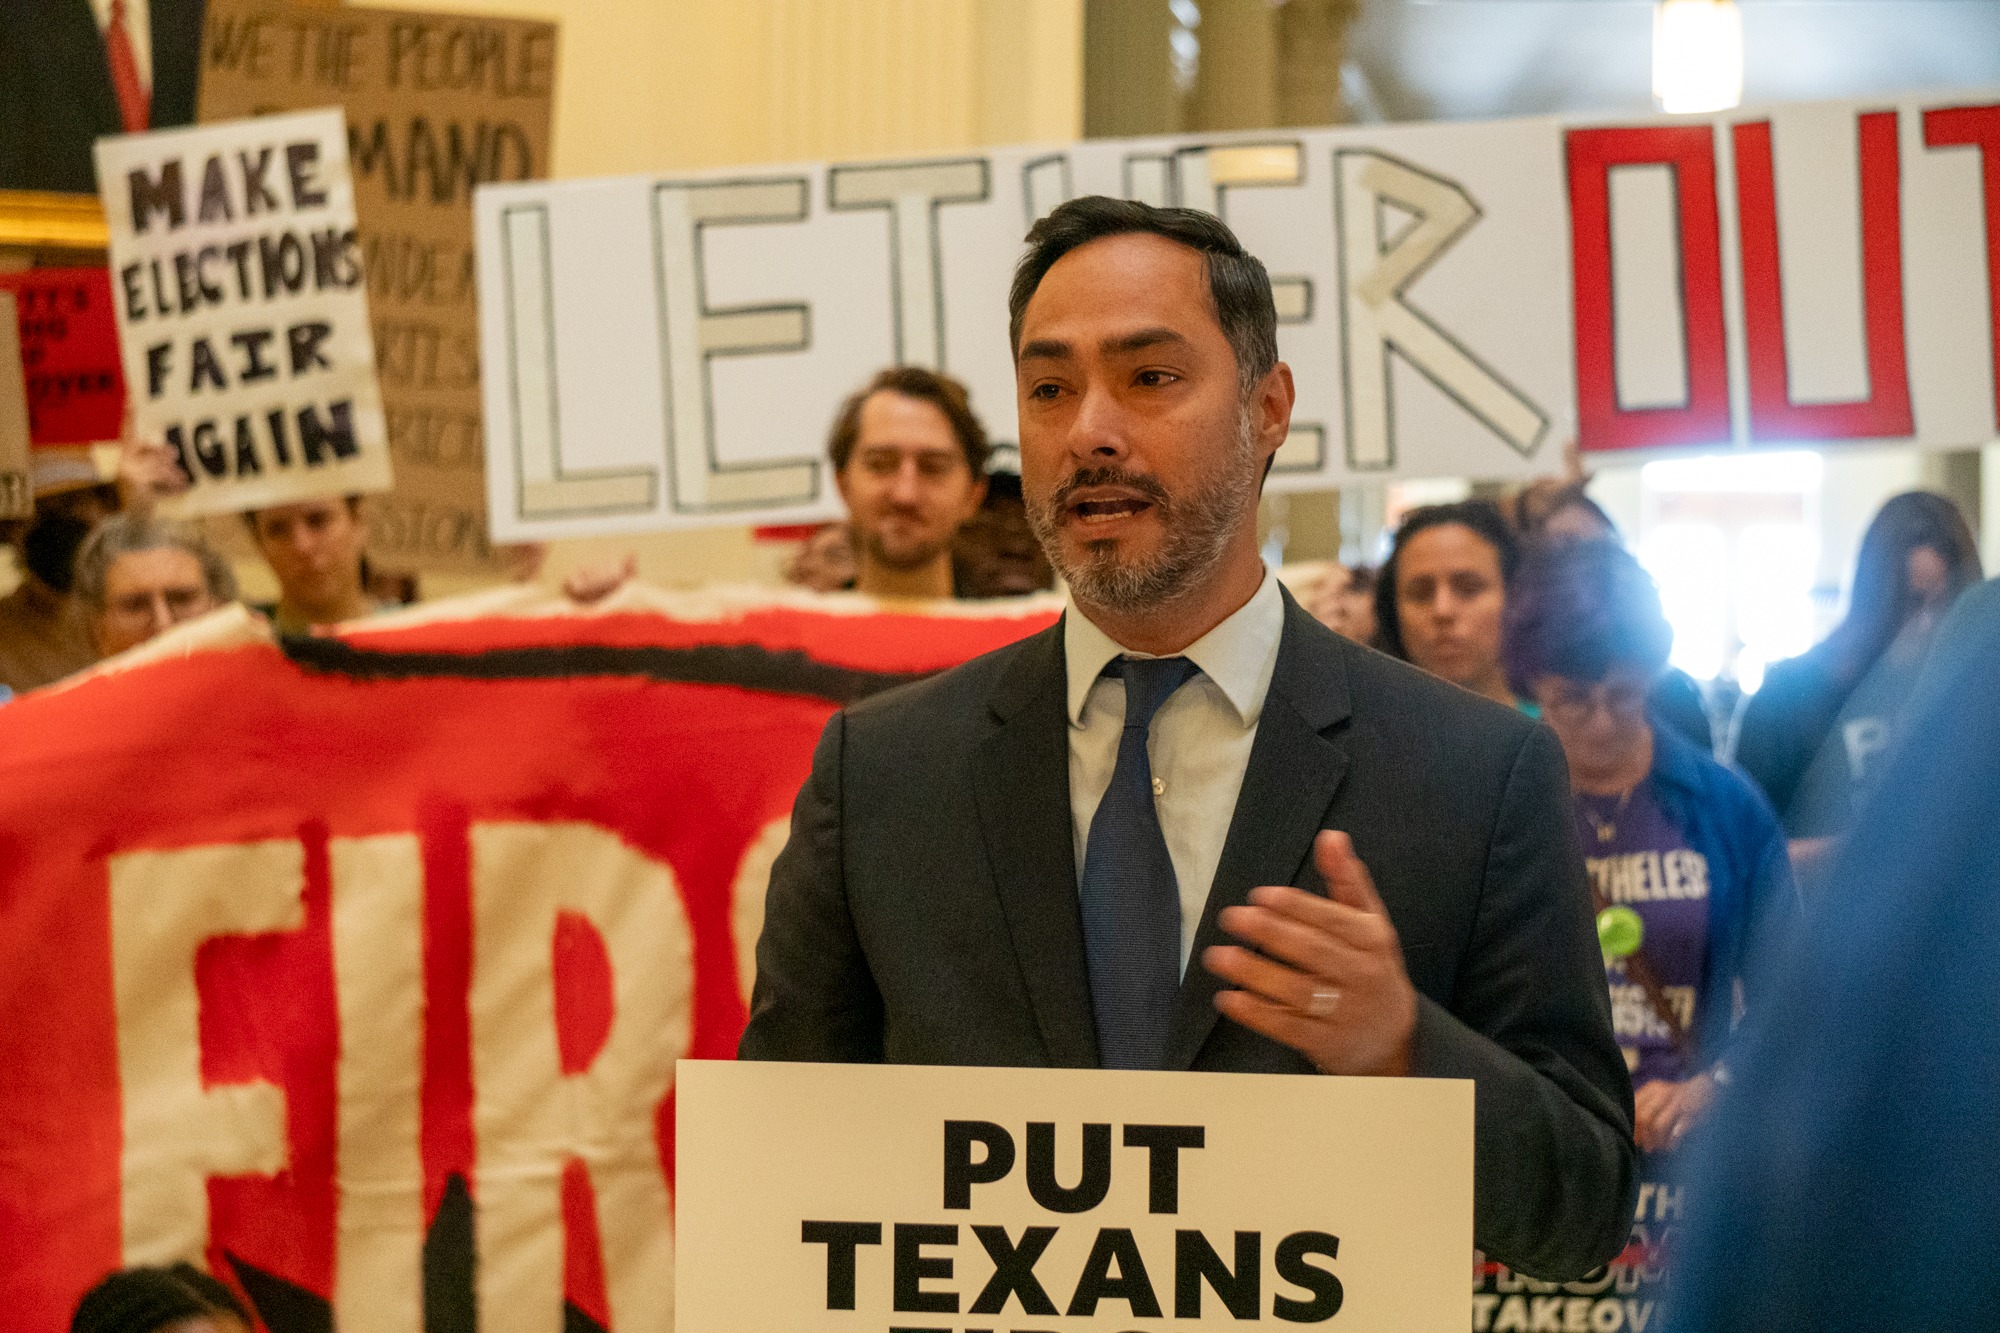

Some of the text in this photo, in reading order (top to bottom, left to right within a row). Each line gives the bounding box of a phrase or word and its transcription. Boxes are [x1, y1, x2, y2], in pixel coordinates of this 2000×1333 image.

[202, 14, 553, 98] WE THE PEOPLE
[128, 142, 328, 234] MAKE
[120, 227, 364, 323] ELECTIONS
[147, 321, 334, 399] FAIR
[503, 157, 991, 520] LET
[1585, 850, 1709, 900] THELES
[110, 816, 795, 1333] FIR
[943, 1119, 1205, 1214] PUT
[801, 1220, 1344, 1323] TEXANS
[1473, 1294, 1655, 1333] TAKEOV
